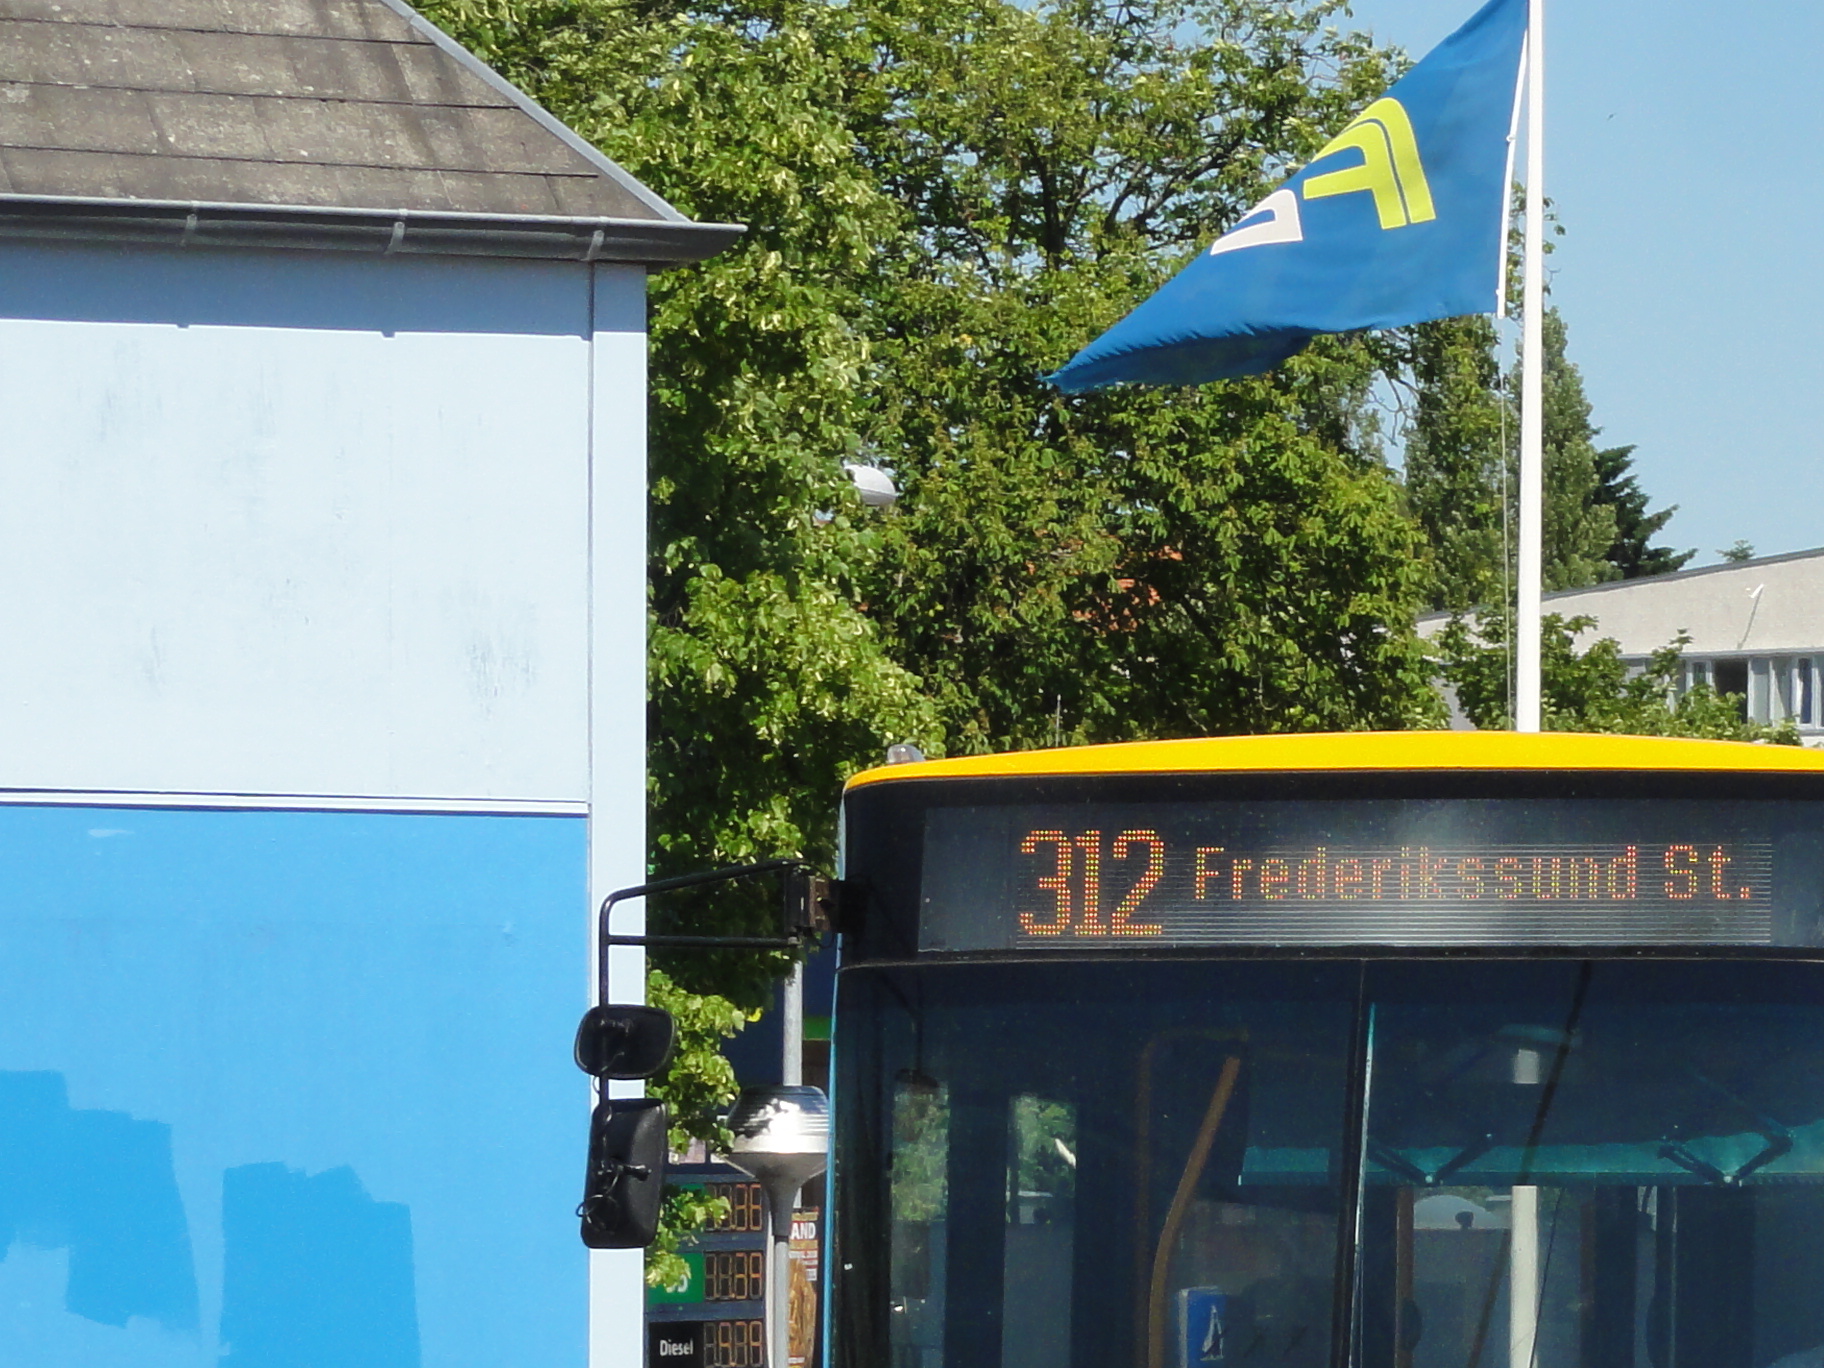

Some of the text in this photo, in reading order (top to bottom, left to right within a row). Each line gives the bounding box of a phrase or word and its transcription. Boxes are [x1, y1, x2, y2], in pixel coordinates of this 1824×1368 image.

[1018, 828, 1752, 936] 312 Frederikssund St.
[660, 1338, 694, 1357] Diesel
